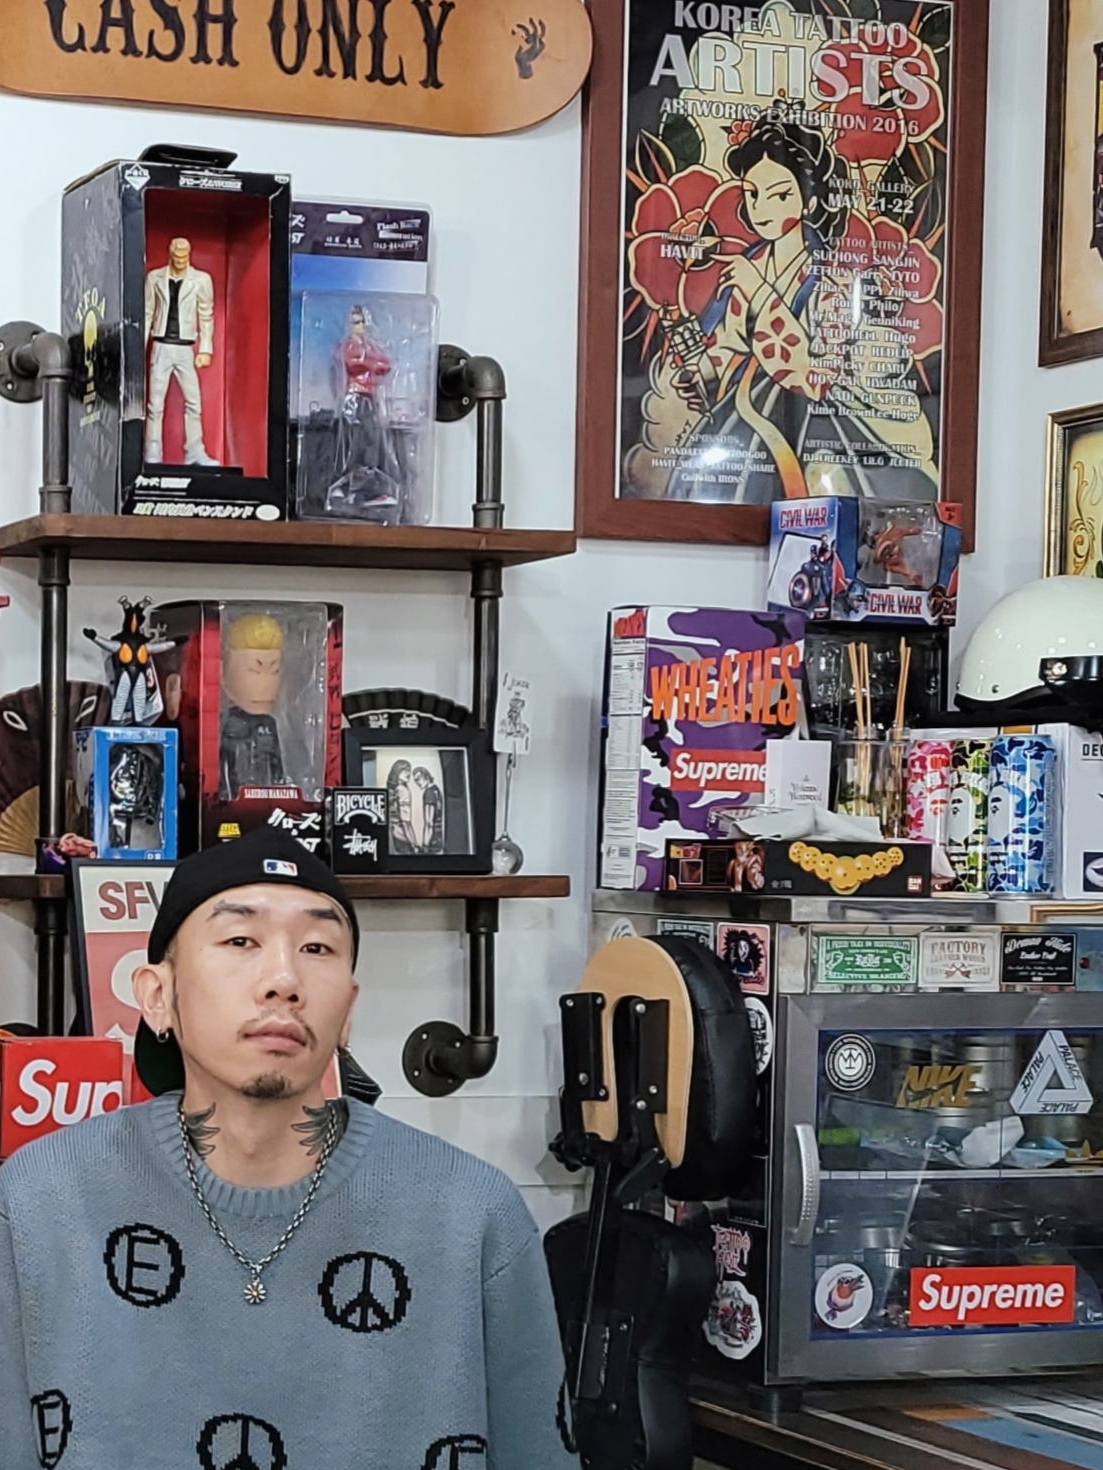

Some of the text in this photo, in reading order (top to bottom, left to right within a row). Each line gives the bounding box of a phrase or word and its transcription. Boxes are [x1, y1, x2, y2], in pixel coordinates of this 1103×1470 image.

[675, 0, 908, 49] KOREA TATTOO
[45, 0, 458, 90] CASH ONLY
[649, 33, 931, 111] ARTISTS
[660, 97, 920, 136] ARTWORKS EXHIBITION 2016
[828, 192, 914, 213] MAY 21-22
[872, 253, 920, 269] SANGJIN
[869, 299, 899, 312] Philo
[812, 341, 866, 356] JACKPOT
[779, 506, 828, 529] CIVIL WAR
[869, 592, 923, 615] CIVIL WAR
[650, 644, 801, 727] WHEATIES
[673, 752, 767, 788] Supreme
[336, 794, 386, 824] BICYCLE
[930, 940, 987, 956] FACTORY
[1020, 1050, 1045, 1093] PALACE
[1059, 1044, 1083, 1081] PALACE
[901, 1065, 983, 1092] NIKE
[1039, 1102, 1079, 1113] PALACE
[918, 1273, 1065, 1320] Supreme
